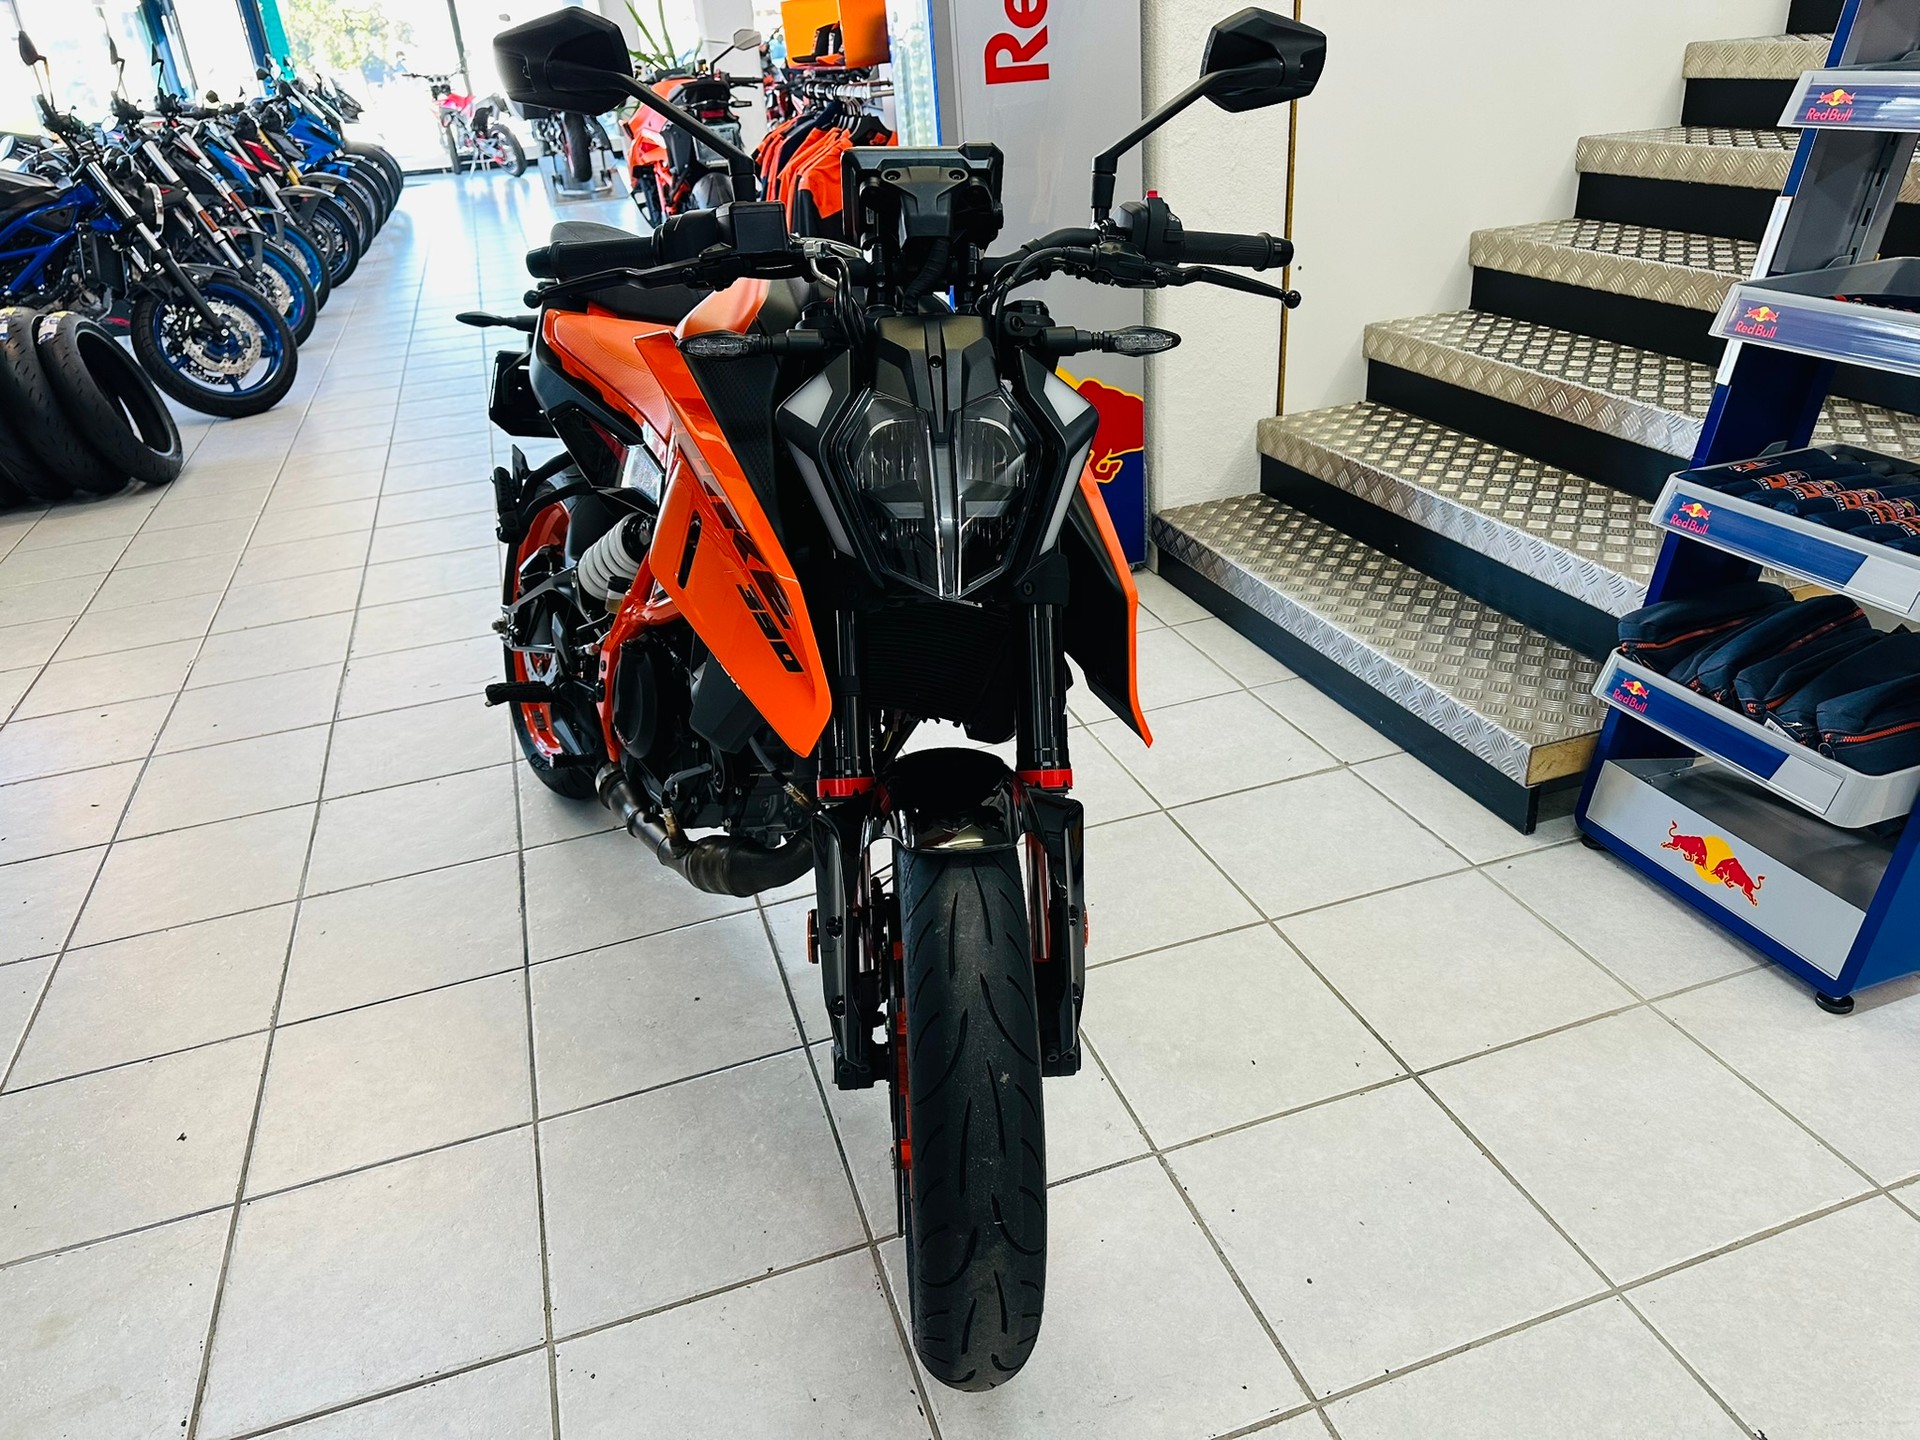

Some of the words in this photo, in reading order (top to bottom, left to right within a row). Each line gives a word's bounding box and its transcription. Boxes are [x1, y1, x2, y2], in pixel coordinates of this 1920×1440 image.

[1805, 107, 1831, 120] Red
[1829, 108, 1853, 121] Bull
[1735, 320, 1757, 335] Red
[1754, 324, 1778, 339] Bull
[1670, 513, 1690, 528] Red
[1688, 519, 1709, 535] Bull
[736, 583, 805, 672] 390
[1612, 688, 1631, 704] Red
[1628, 696, 1648, 713] Bull
